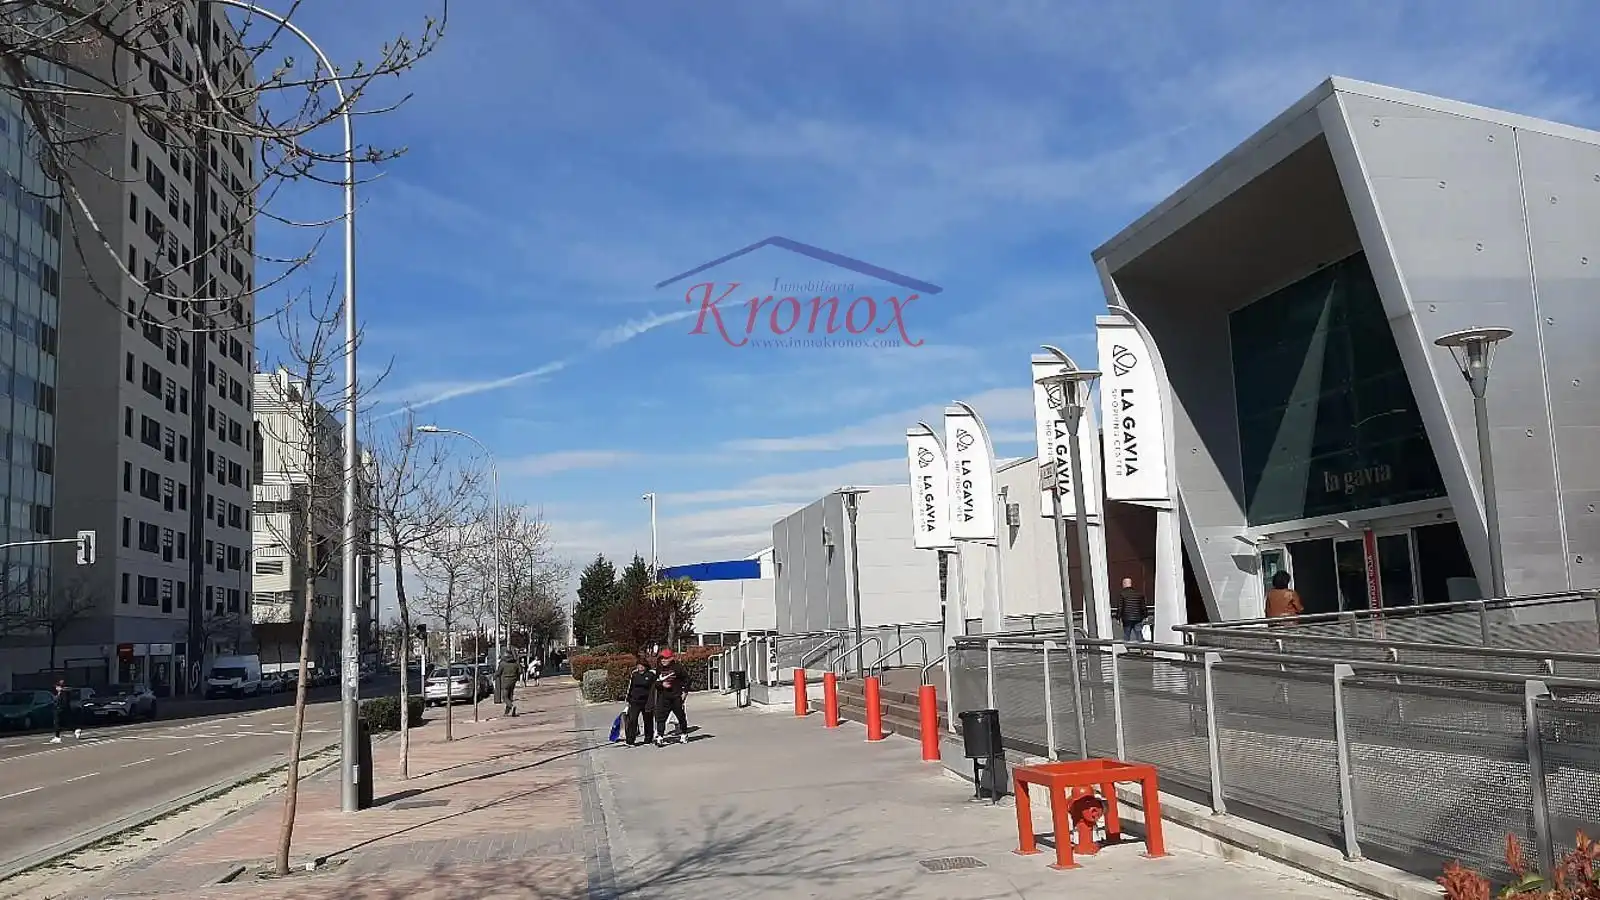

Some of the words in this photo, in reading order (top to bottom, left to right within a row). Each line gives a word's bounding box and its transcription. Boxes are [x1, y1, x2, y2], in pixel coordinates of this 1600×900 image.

[1121, 388, 1134, 411] LA
[1054, 419, 1066, 439] LA
[1122, 416, 1139, 477] GAVIA
[923, 475, 933, 490] LA
[961, 460, 972, 476] LA
[1056, 444, 1070, 496] GAVIA
[1323, 471, 1341, 493] la
[1343, 464, 1391, 495] gavia
[925, 493, 936, 532] GAVIA
[962, 480, 974, 522] GAVIA
